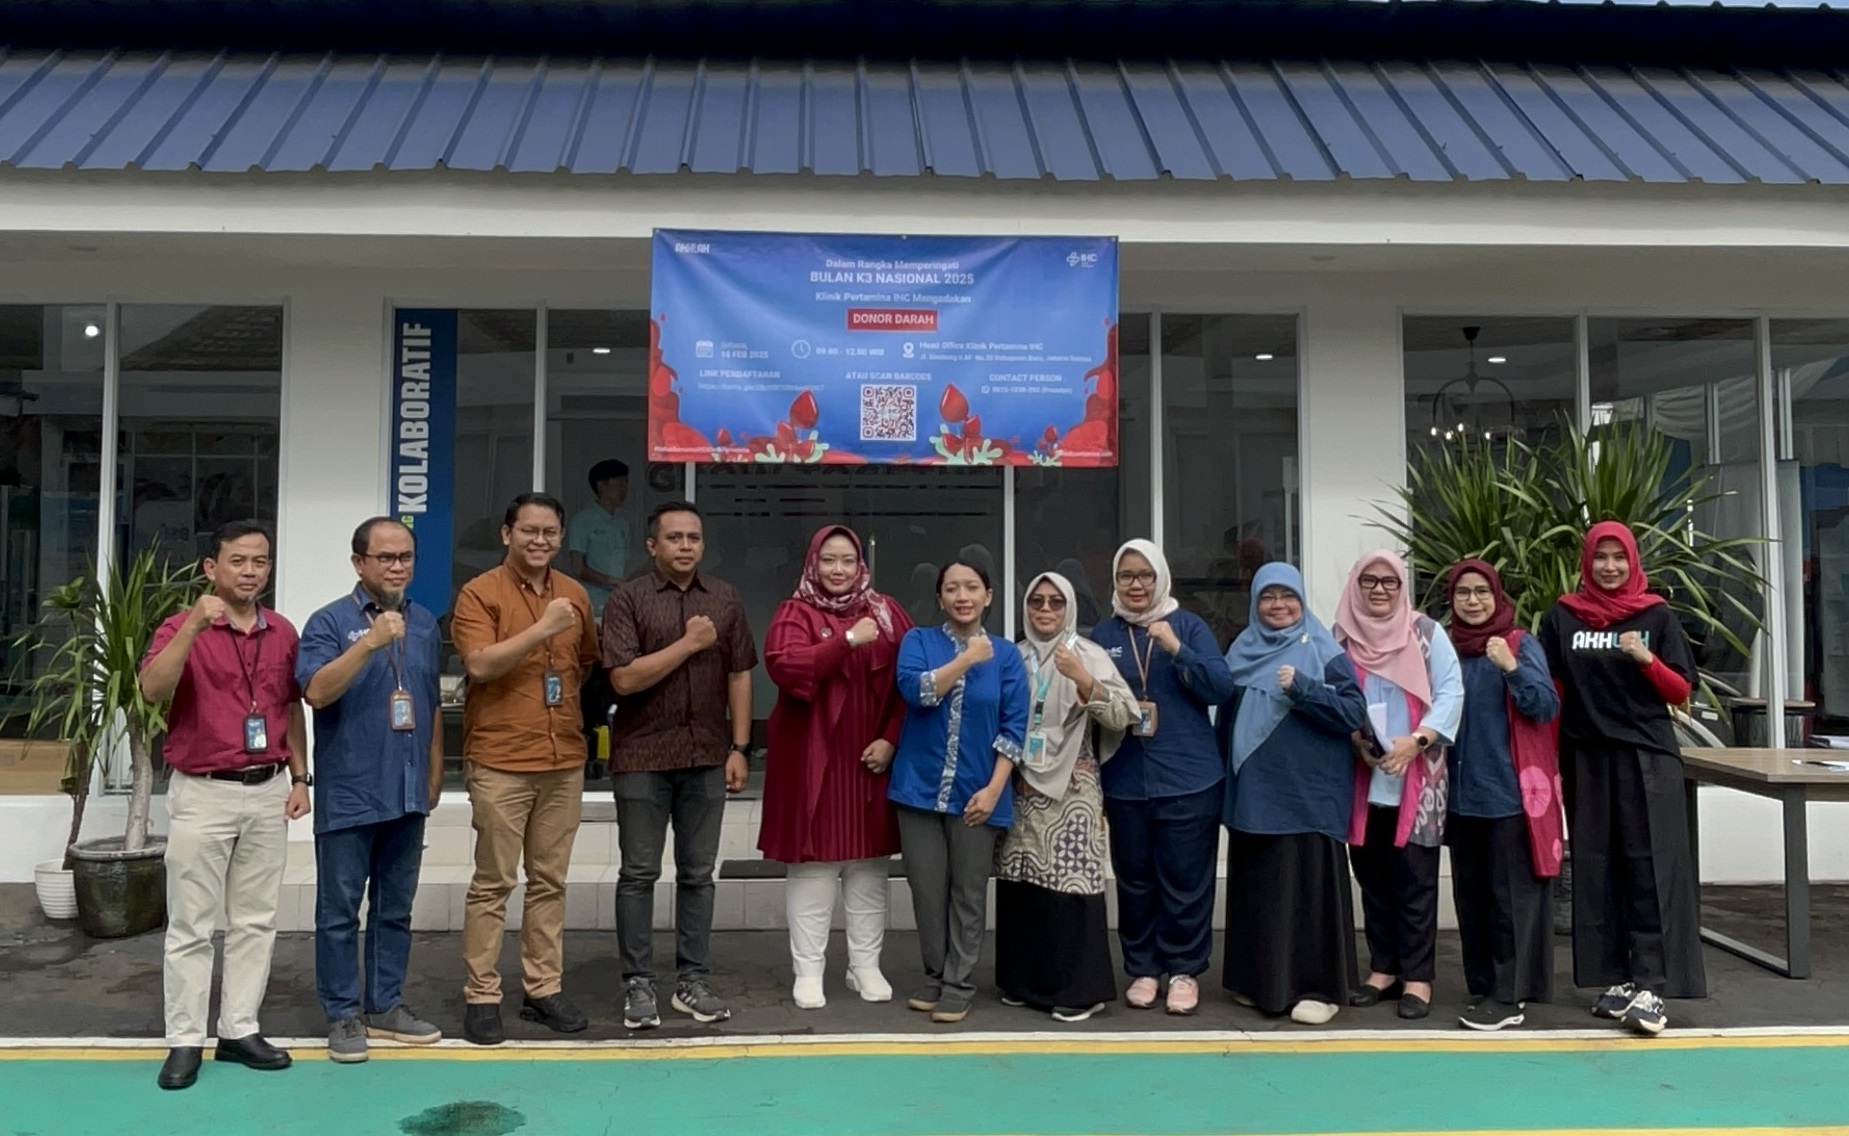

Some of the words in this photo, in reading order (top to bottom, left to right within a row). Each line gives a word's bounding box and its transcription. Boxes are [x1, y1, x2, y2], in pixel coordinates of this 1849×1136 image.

[1080, 253, 1098, 262] IHC
[826, 259, 856, 269] Dalam
[858, 260, 893, 271] Rangka
[894, 260, 960, 271] Memperingati
[810, 271, 853, 283] BULAN
[856, 272, 873, 284] K3
[875, 272, 941, 284] NASIONAL
[944, 273, 975, 285] 2025
[815, 291, 841, 301] Klinik
[844, 292, 891, 302] Pertamina
[893, 293, 911, 303] IHC
[912, 293, 972, 304] Mengadakan
[853, 313, 892, 324] DONOR
[894, 314, 934, 325] DARAH
[699, 369, 719, 378] LINK
[845, 371, 868, 380] ATAU
[869, 371, 893, 380] SCAN
[989, 373, 1027, 382] CONTACT
[1029, 373, 1063, 382] PERSON
[398, 322, 432, 513] KOLABORATIF
[1572, 630, 1650, 650] AKHLK
